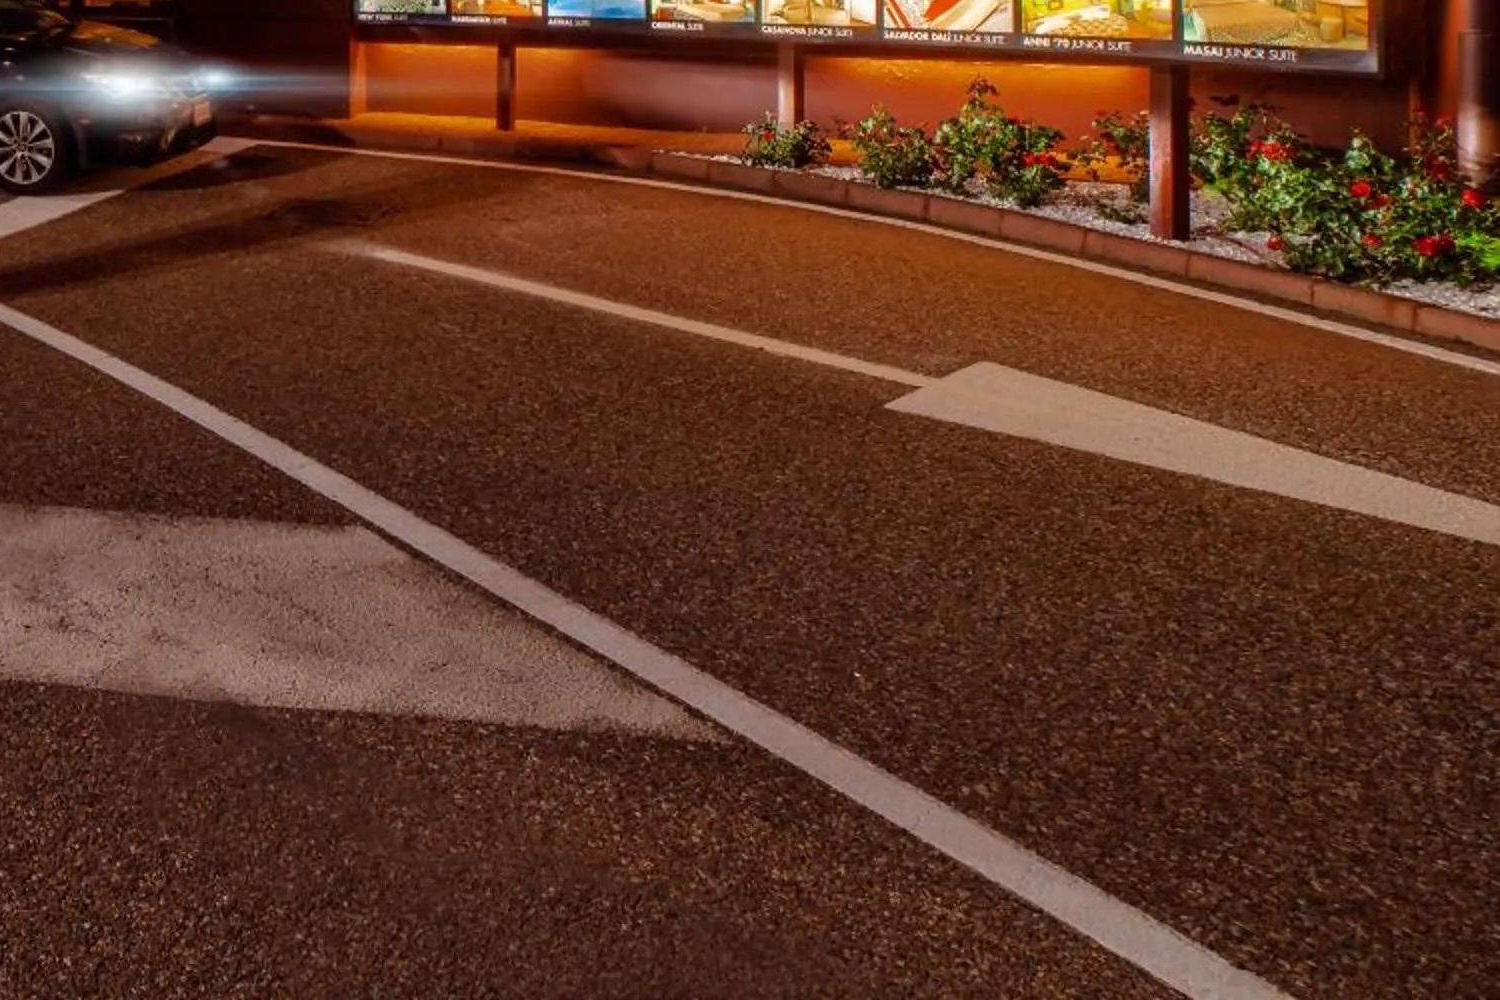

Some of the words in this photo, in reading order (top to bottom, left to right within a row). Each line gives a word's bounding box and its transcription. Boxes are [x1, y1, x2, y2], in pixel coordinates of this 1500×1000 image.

[762, 25, 807, 36] CASANOVA
[808, 27, 833, 37] JUNIOR
[883, 30, 929, 41] SALVADOR
[954, 34, 981, 43] JUNIOR
[984, 35, 1005, 44] SUITE
[1023, 37, 1051, 47] ANNI
[1072, 39, 1105, 50] JUNIOR
[1107, 40, 1132, 51] SUITE
[1183, 45, 1223, 57] MASAI
[1224, 47, 1266, 59] JUNIOR
[1268, 49, 1297, 62] SUITE
